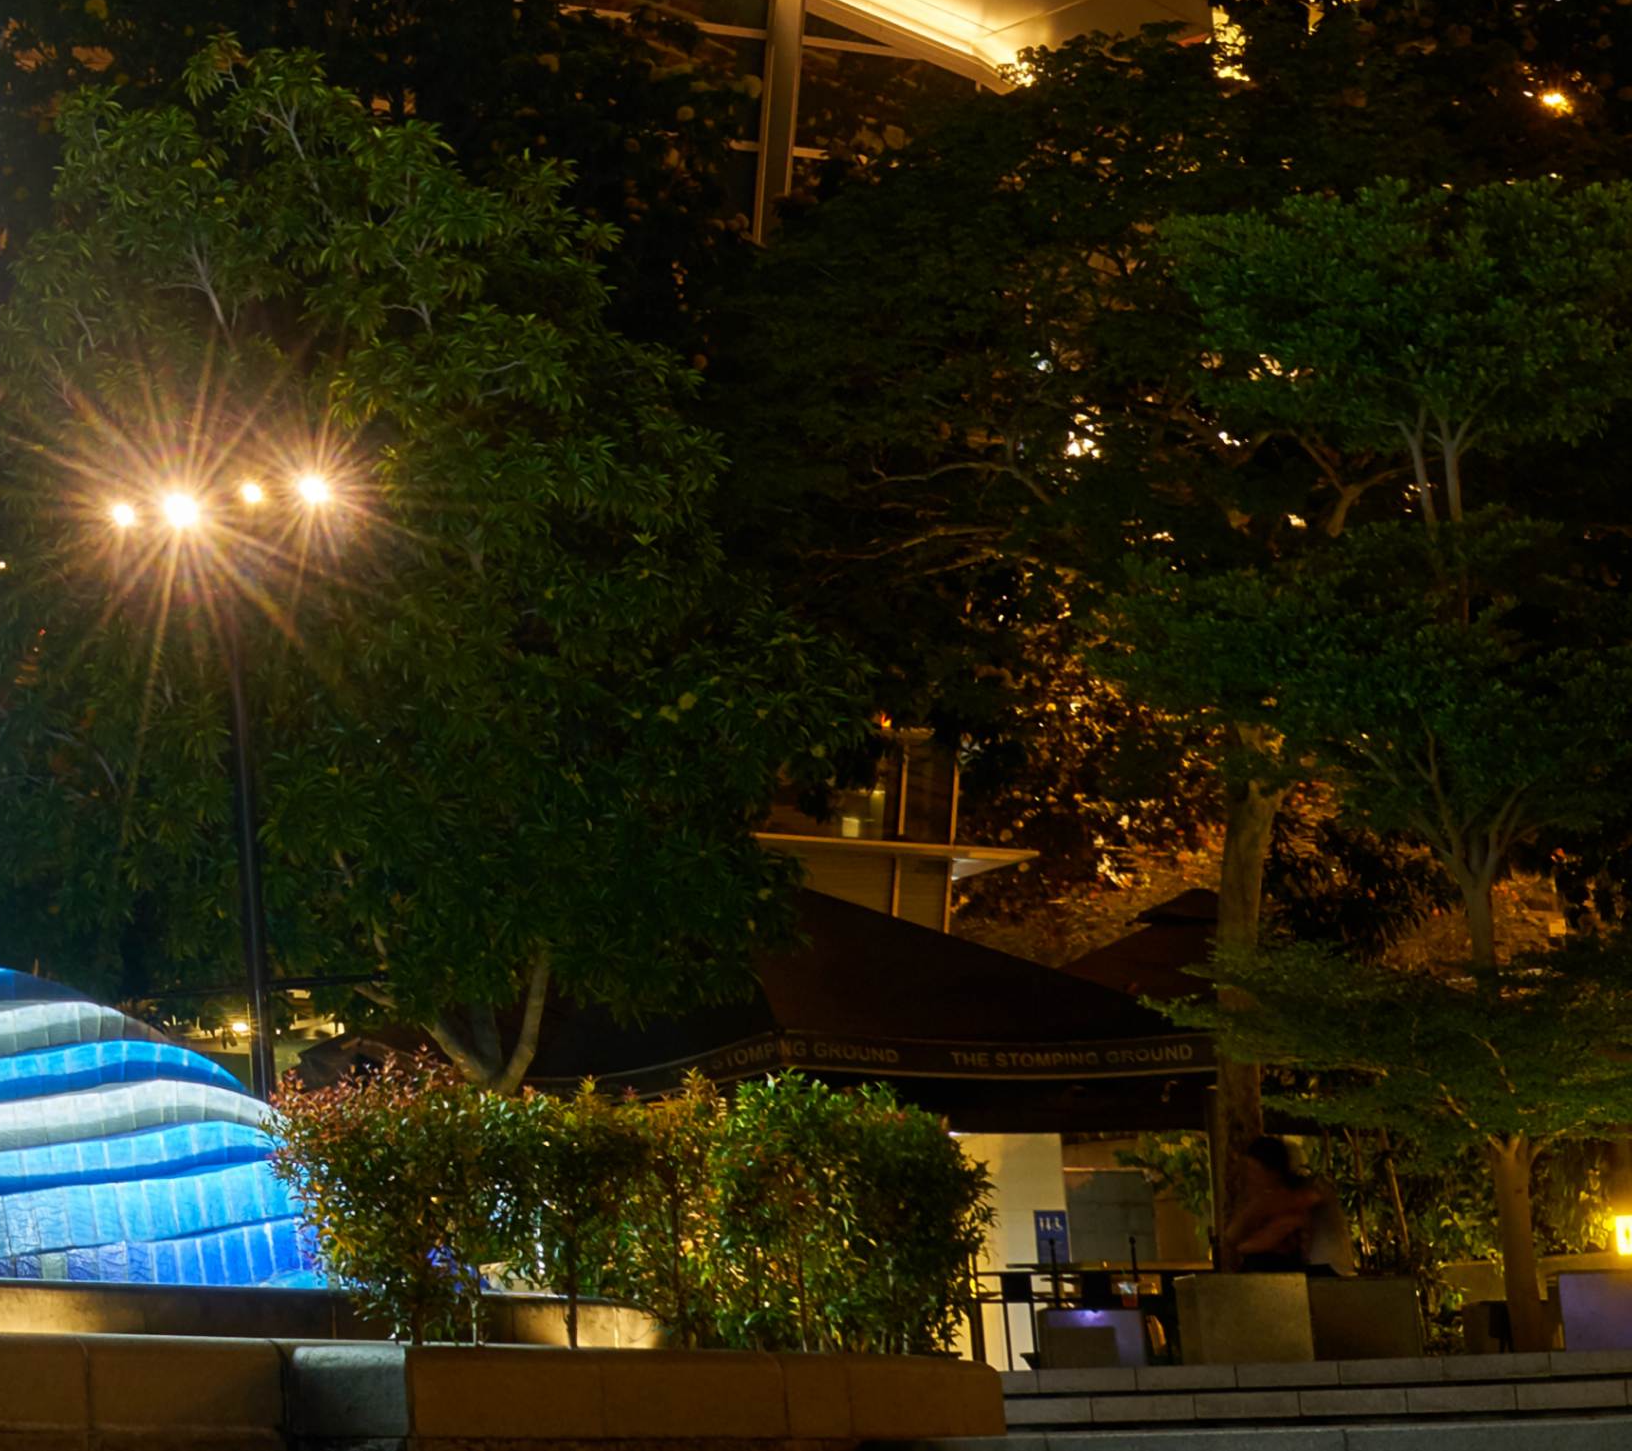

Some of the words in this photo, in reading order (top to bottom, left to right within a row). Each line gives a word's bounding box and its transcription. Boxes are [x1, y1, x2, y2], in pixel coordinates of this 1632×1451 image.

[813, 1041, 900, 1065] GROUND
[950, 1050, 990, 1067] THE
[994, 1049, 1098, 1068] STOMPING
[1104, 1043, 1194, 1065] GROUND
